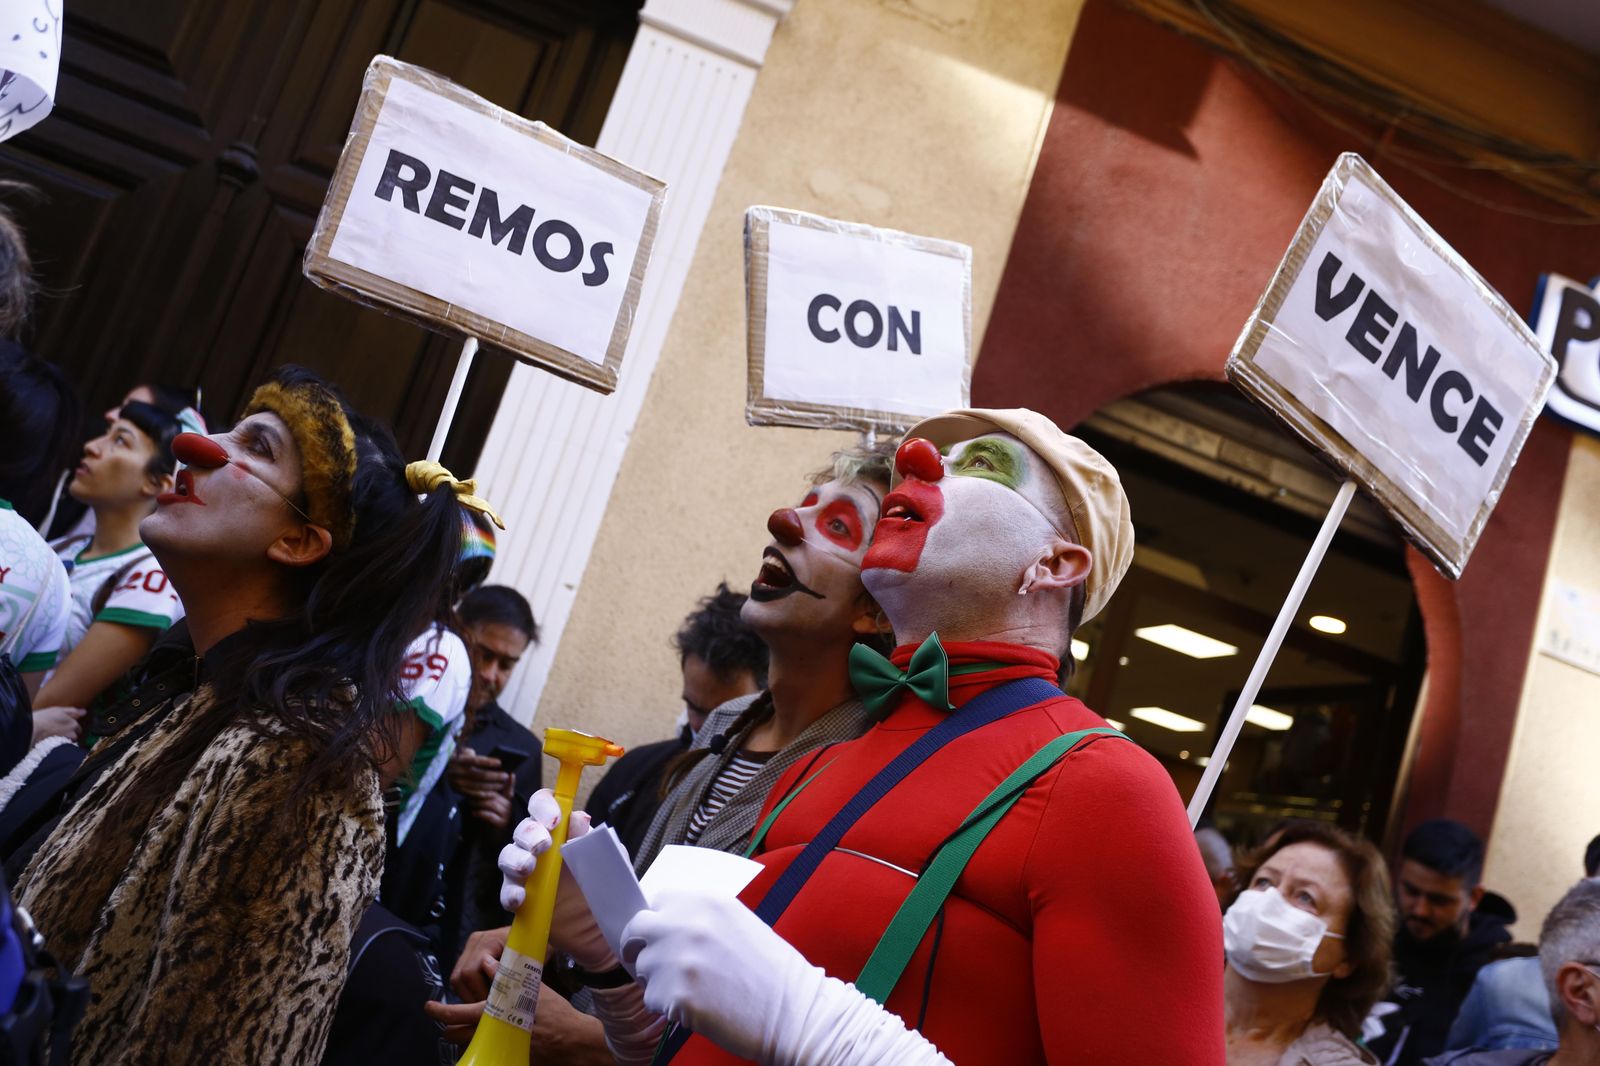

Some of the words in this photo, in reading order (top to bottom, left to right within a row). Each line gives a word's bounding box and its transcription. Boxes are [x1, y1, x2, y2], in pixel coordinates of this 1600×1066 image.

[374, 148, 614, 287] REMOS
[807, 293, 922, 356] CON
[1315, 251, 1504, 467] VENCE
[1550, 286, 1600, 378] P
